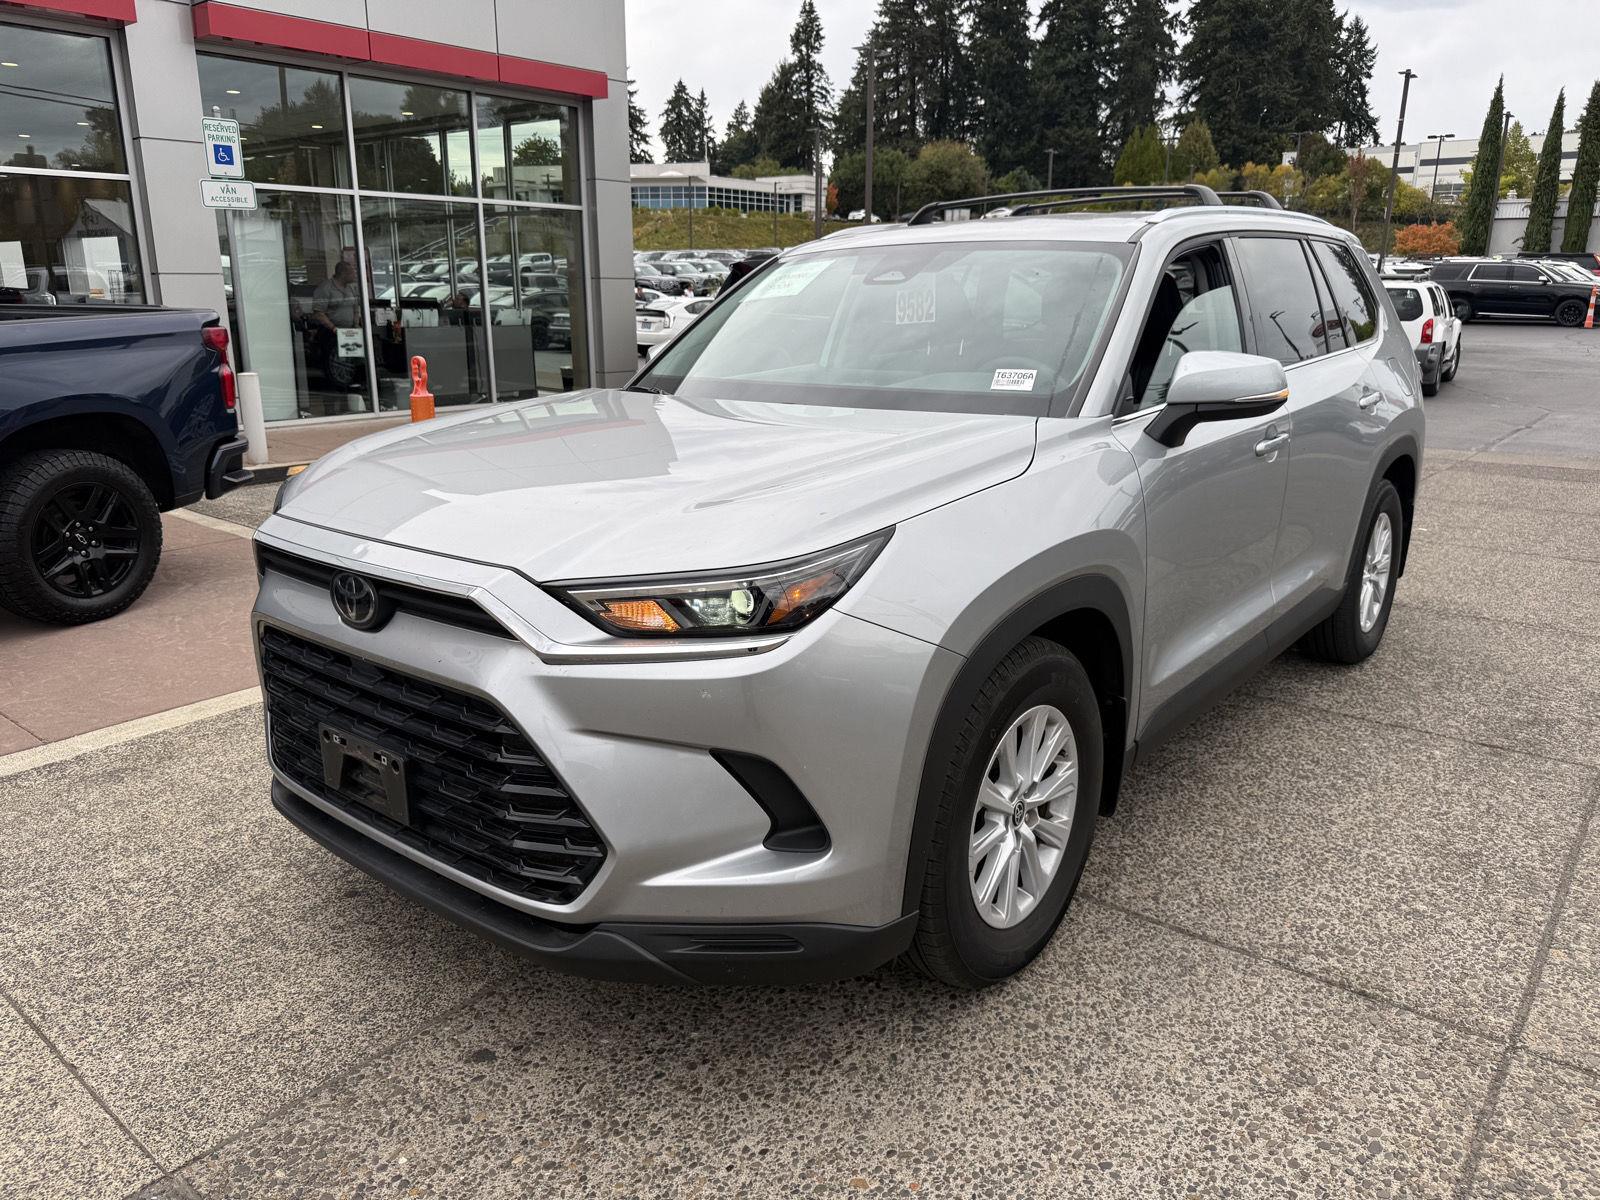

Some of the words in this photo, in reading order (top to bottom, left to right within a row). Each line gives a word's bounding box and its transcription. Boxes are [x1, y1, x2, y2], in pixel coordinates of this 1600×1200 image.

[204, 123, 237, 134] RESERVED
[207, 133, 236, 144] PARKING
[220, 186, 237, 195] VAN
[210, 196, 248, 204] ACCESSIBLE
[897, 289, 935, 323] 9582
[996, 371, 1034, 380] T63706A
